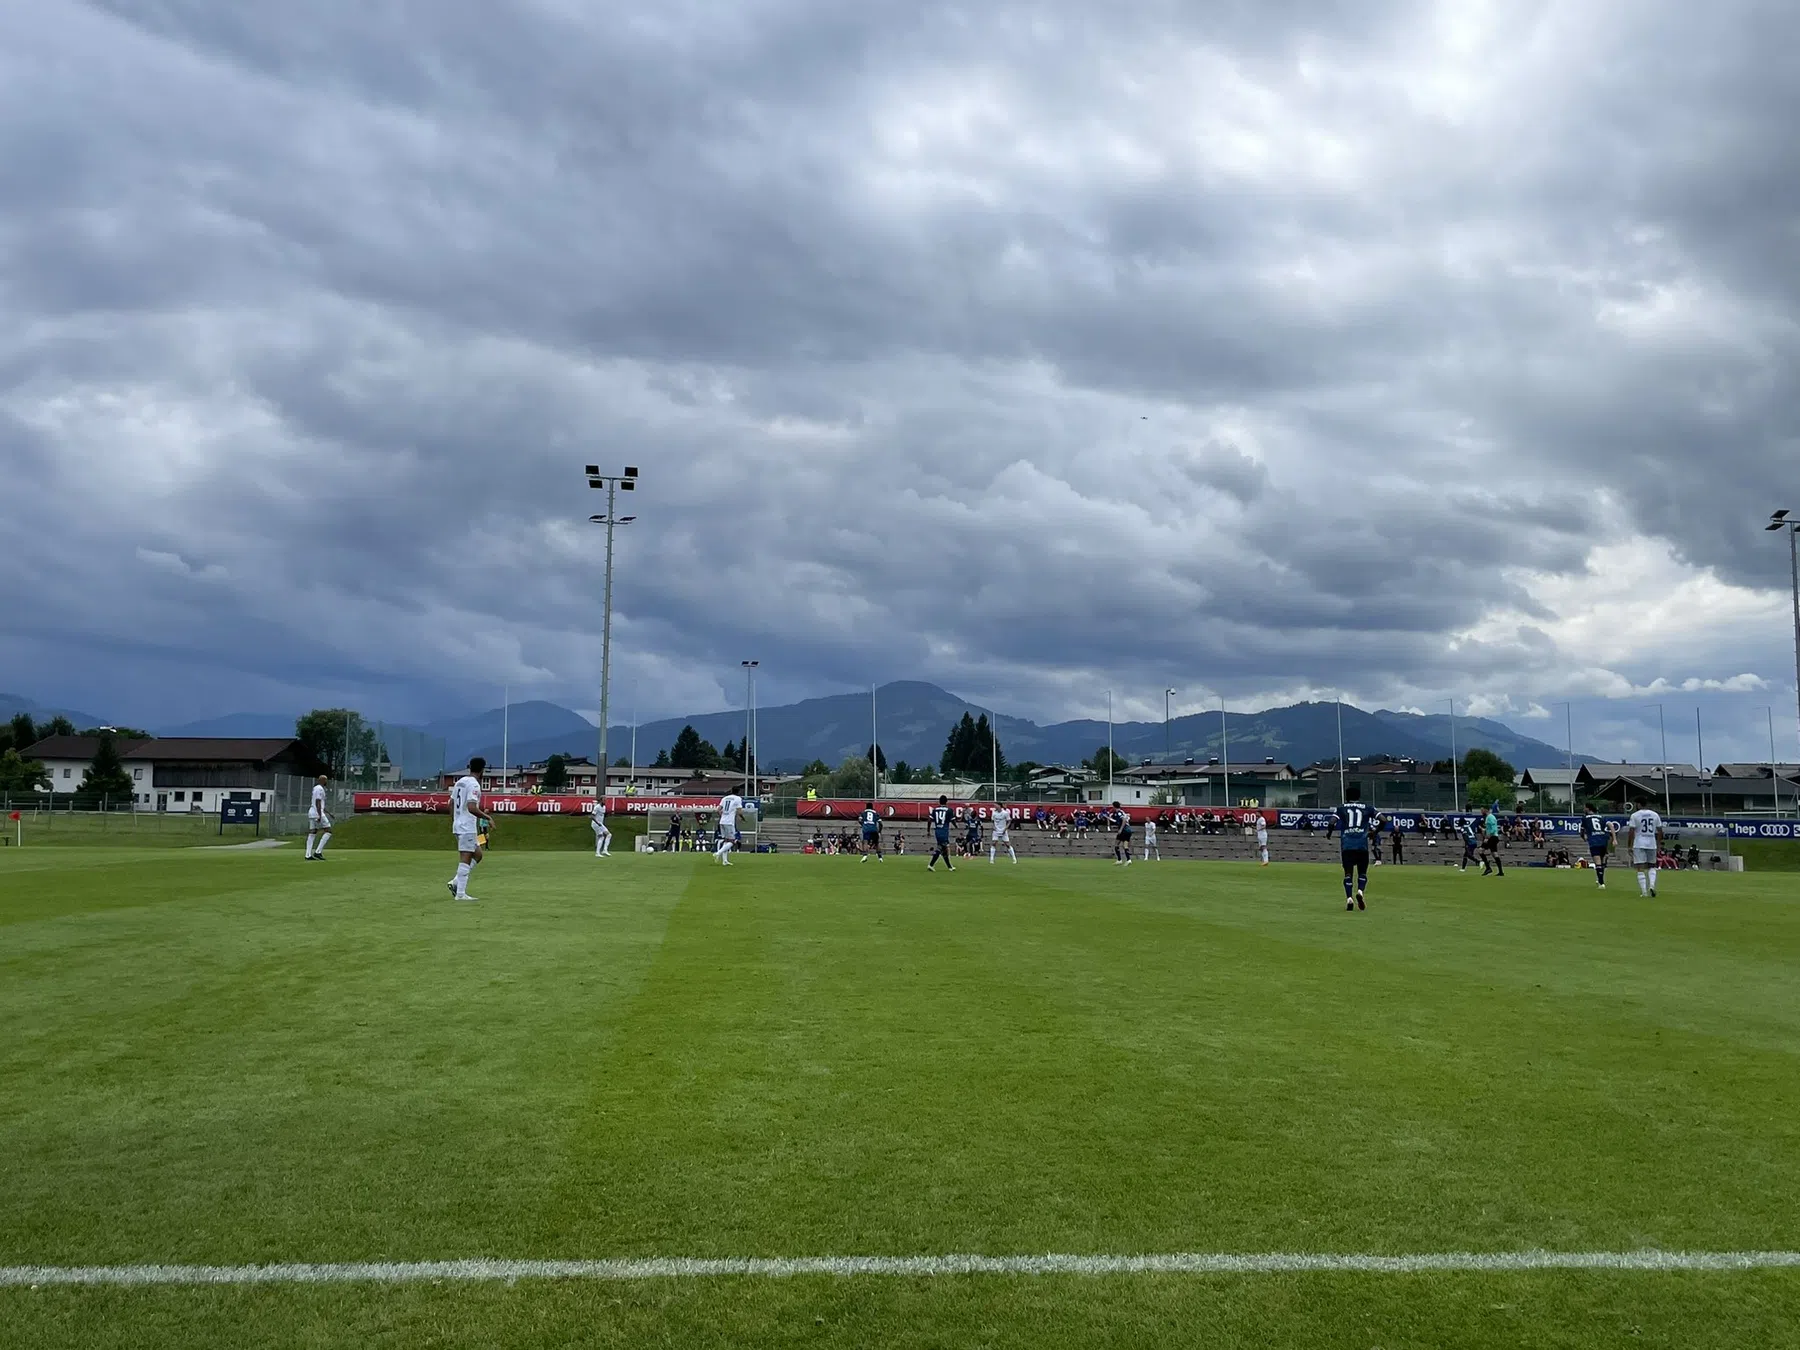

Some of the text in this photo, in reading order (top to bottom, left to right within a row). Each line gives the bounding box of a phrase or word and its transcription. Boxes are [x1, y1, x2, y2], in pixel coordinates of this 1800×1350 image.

[370, 798, 422, 808] Heineken
[456, 789, 461, 809] 5
[492, 800, 517, 812] TOTO
[536, 801, 561, 812] TOTO
[724, 800, 731, 812] 11
[866, 811, 874, 822] 8
[935, 811, 946, 825] 14
[1347, 808, 1363, 828] 11
[1393, 816, 1415, 829] hep
[1591, 817, 1602, 831] 6
[1640, 818, 1654, 834] 35
[1735, 823, 1756, 836] hep
